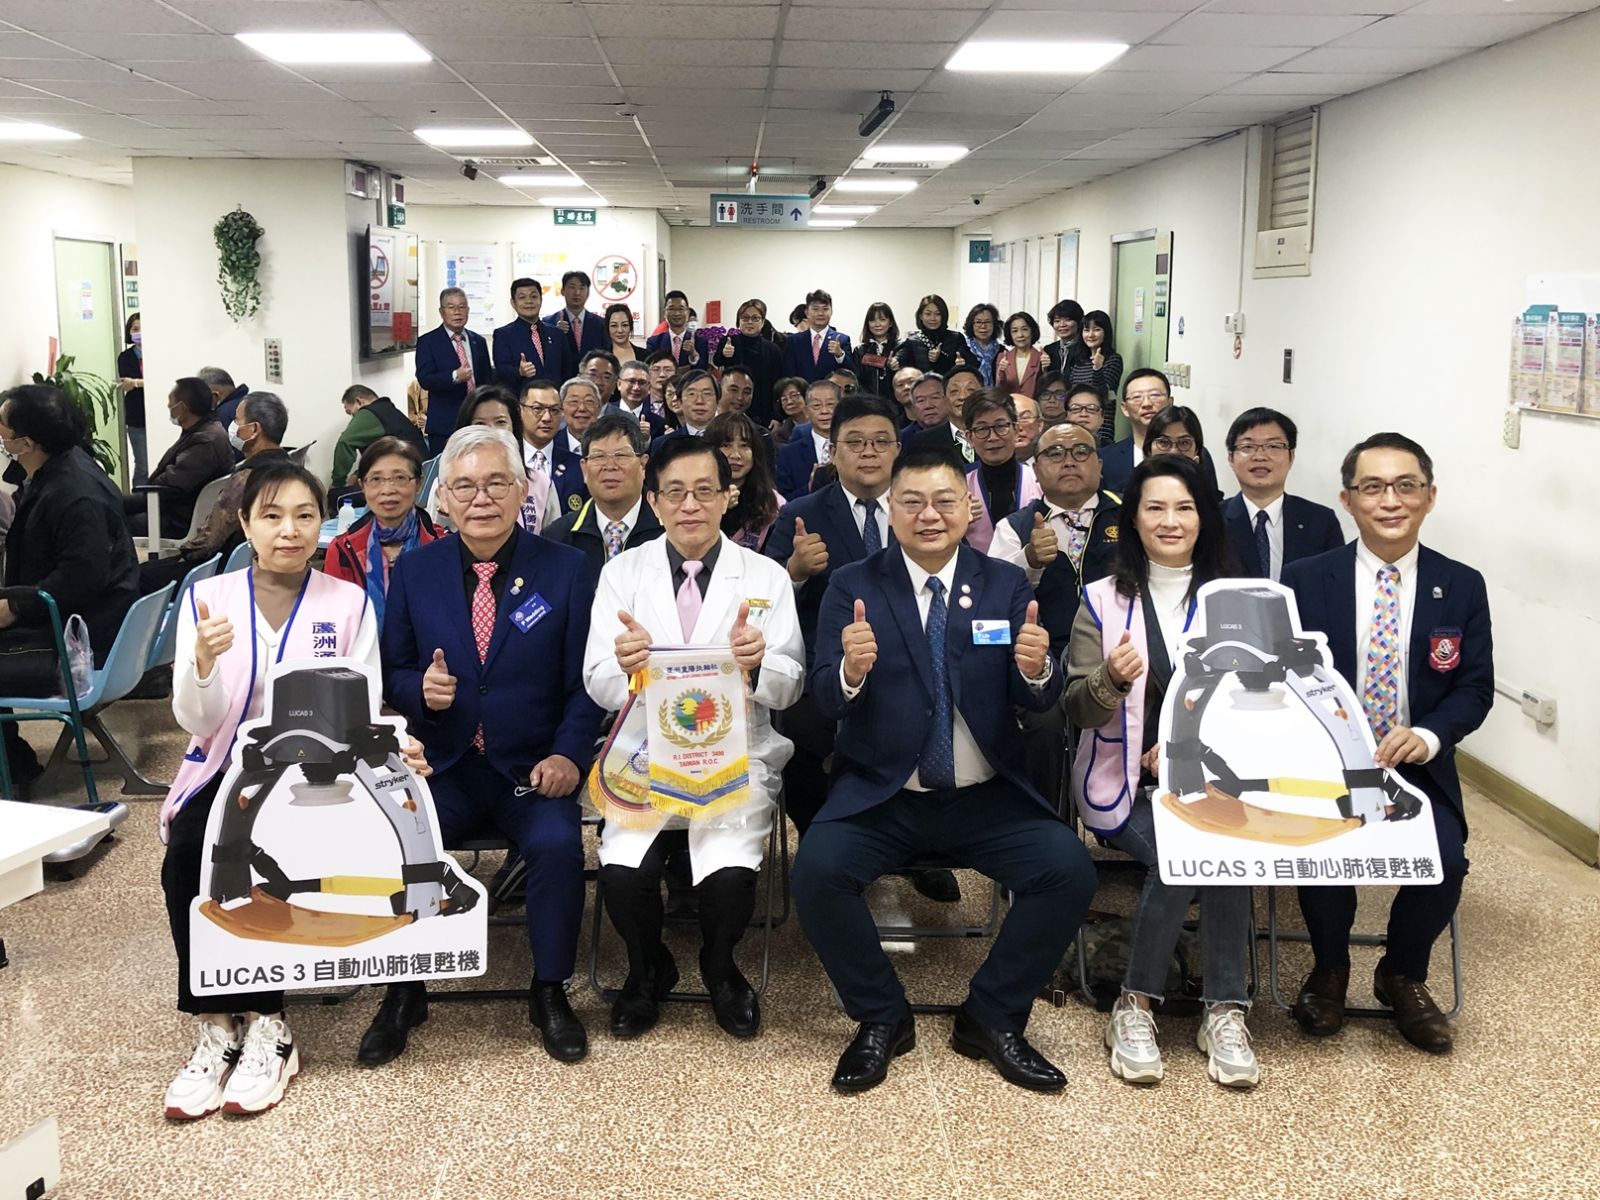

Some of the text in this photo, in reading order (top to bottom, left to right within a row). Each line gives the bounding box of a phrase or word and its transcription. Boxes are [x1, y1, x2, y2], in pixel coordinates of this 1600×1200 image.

[740, 202, 784, 216] 洗手間
[743, 217, 781, 225] RESTROOM
[1306, 684, 1337, 698] stryker
[683, 751, 708, 760] DISTRICT
[374, 774, 409, 790] stryker
[1168, 857, 1436, 880] LUCAS 3 自動心肺復甦機
[199, 949, 480, 988] LUCAS 3 自動心肺復甦機
